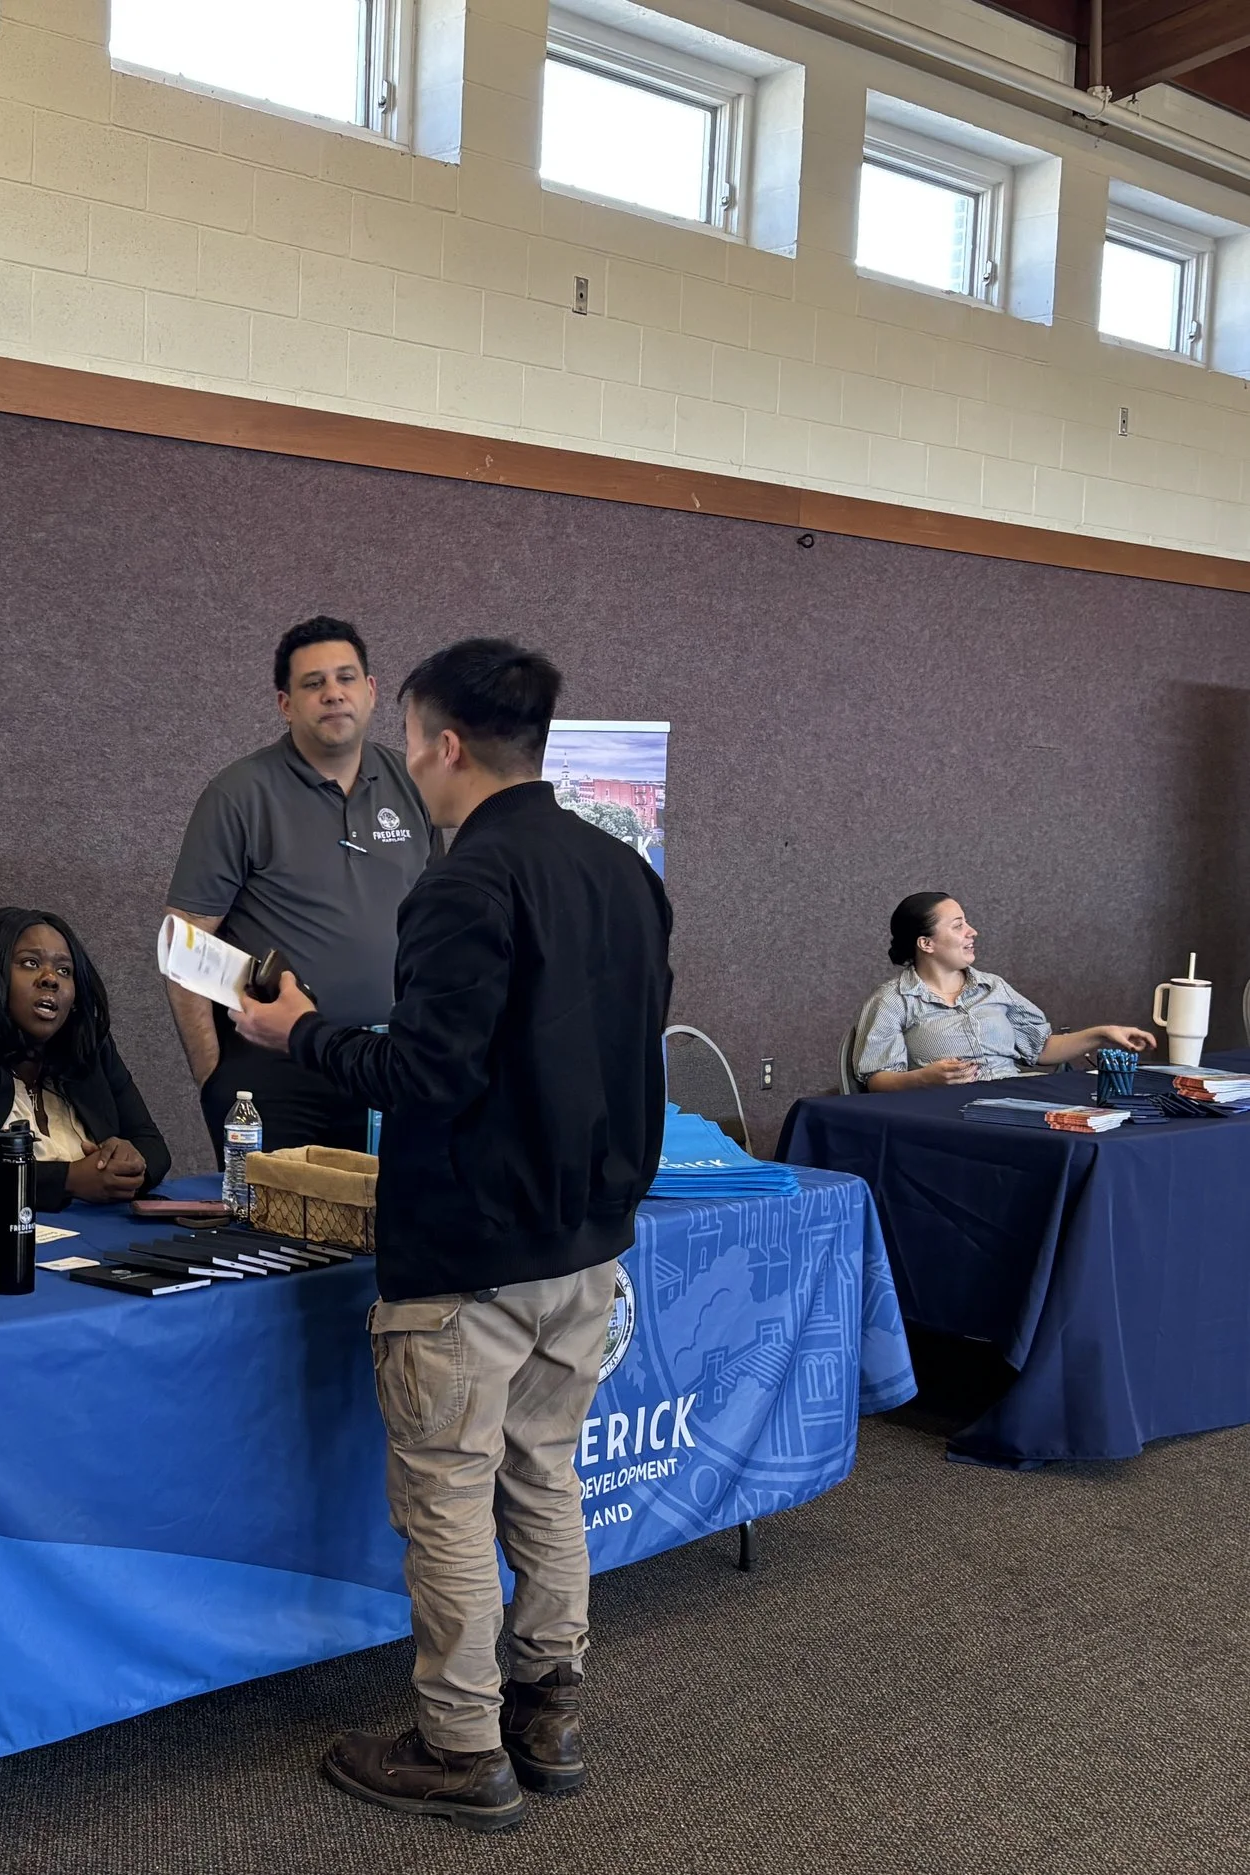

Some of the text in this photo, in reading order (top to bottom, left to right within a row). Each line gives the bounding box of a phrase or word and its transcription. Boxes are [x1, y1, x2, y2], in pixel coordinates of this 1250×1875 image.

[372, 829, 411, 840] FREDERICK
[571, 1393, 697, 1467] ERICK
[582, 1503, 633, 1531] LAND
